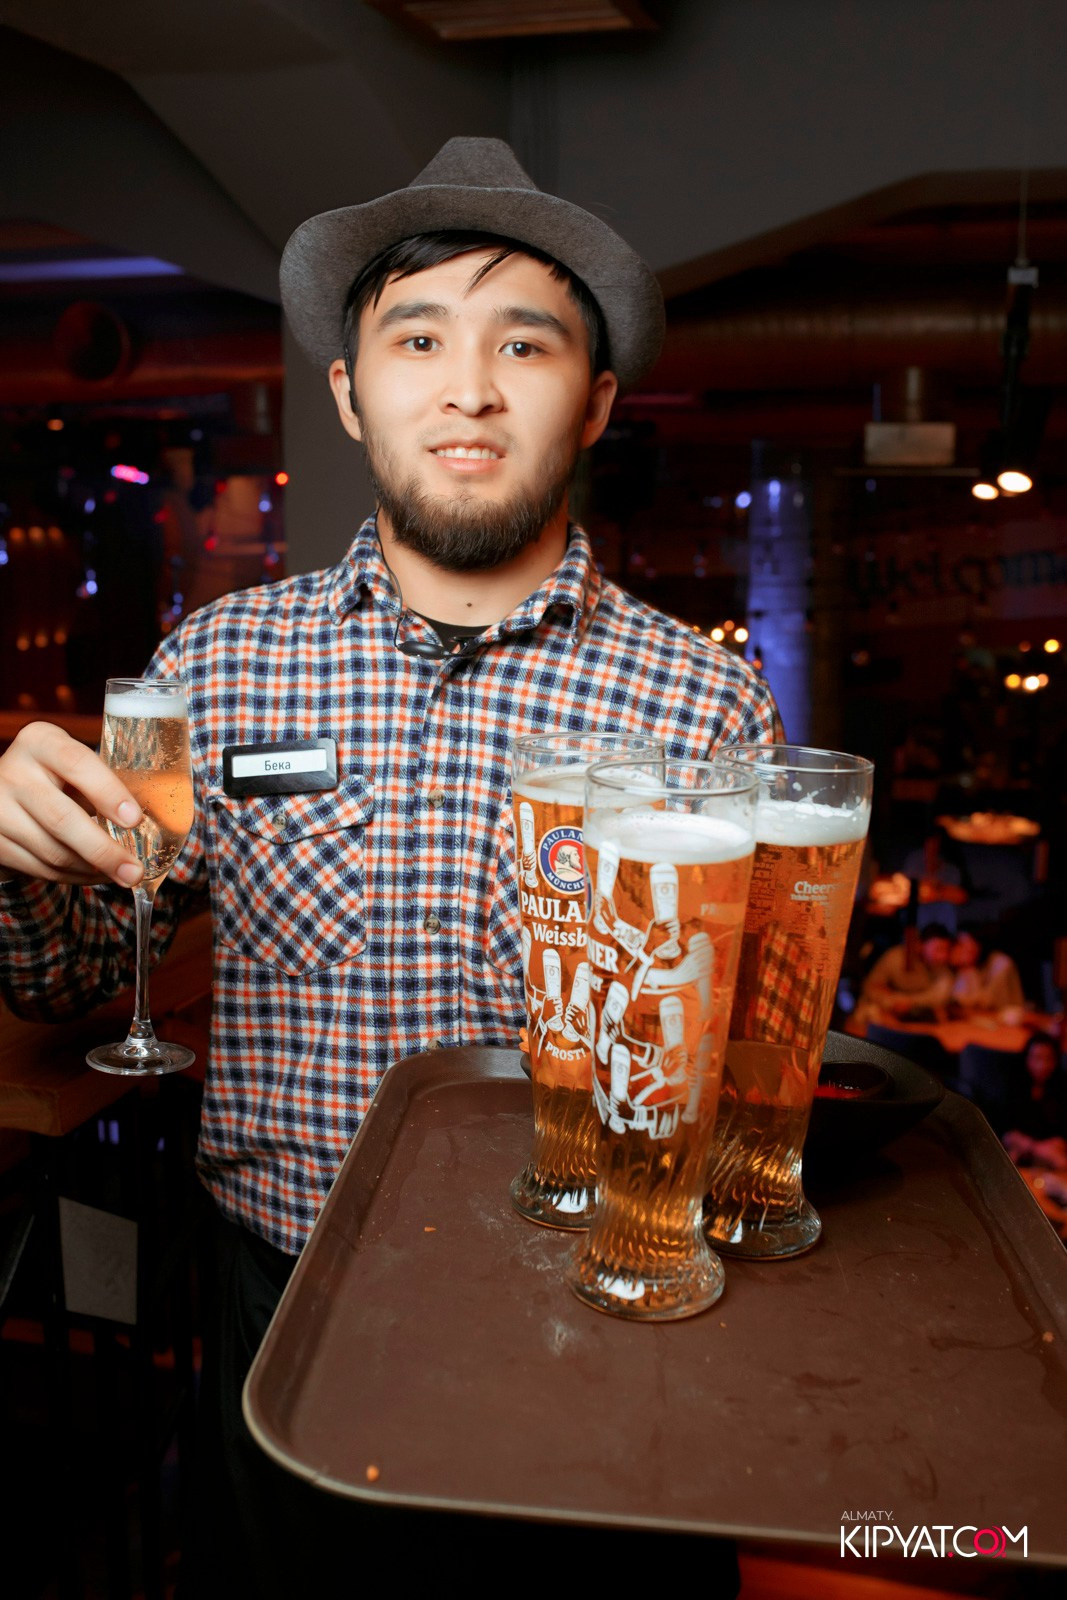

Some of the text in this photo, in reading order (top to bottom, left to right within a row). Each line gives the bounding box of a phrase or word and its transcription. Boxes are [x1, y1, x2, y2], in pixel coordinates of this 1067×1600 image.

[264, 760, 291, 771] Бека
[521, 890, 587, 923] PAULA
[545, 1041, 586, 1061] PROST!
